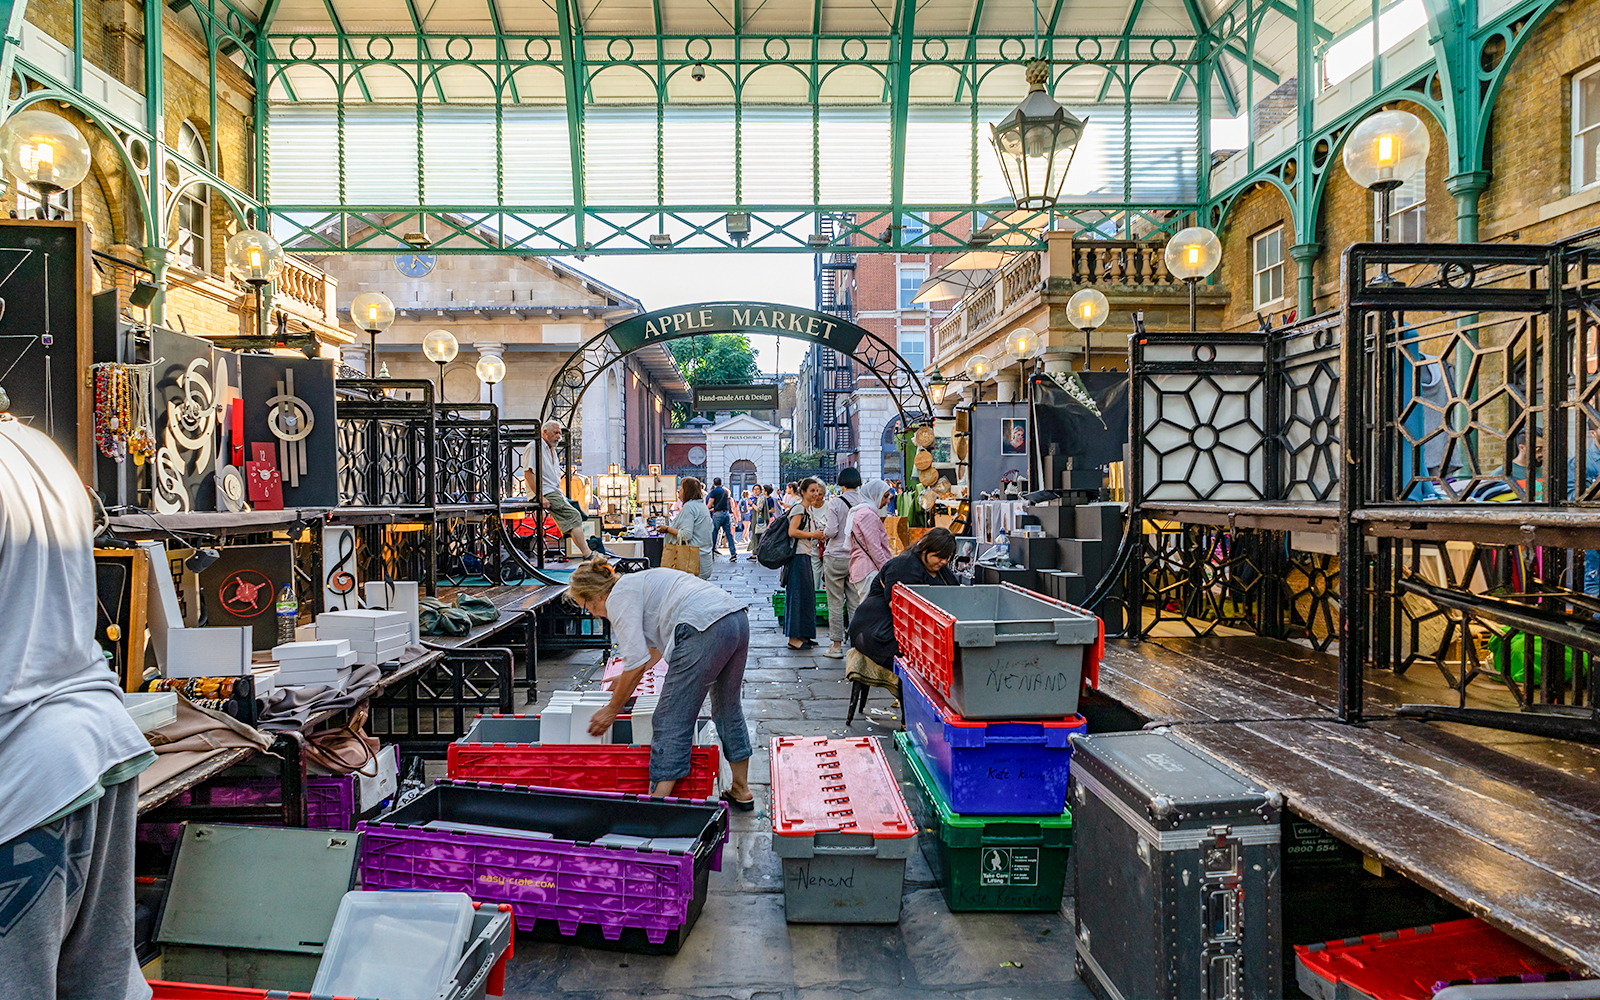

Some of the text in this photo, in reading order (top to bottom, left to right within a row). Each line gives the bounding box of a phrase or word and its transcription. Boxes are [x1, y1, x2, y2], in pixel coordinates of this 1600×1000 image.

[644, 308, 838, 340] APPLE MARKET
[698, 394, 734, 402] Hand-made
[751, 393, 773, 402] Design
[259, 450, 266, 462] 12
[264, 486, 270, 498] 6
[987, 766, 1010, 780] Kate
[1287, 845, 1314, 854] 0800
